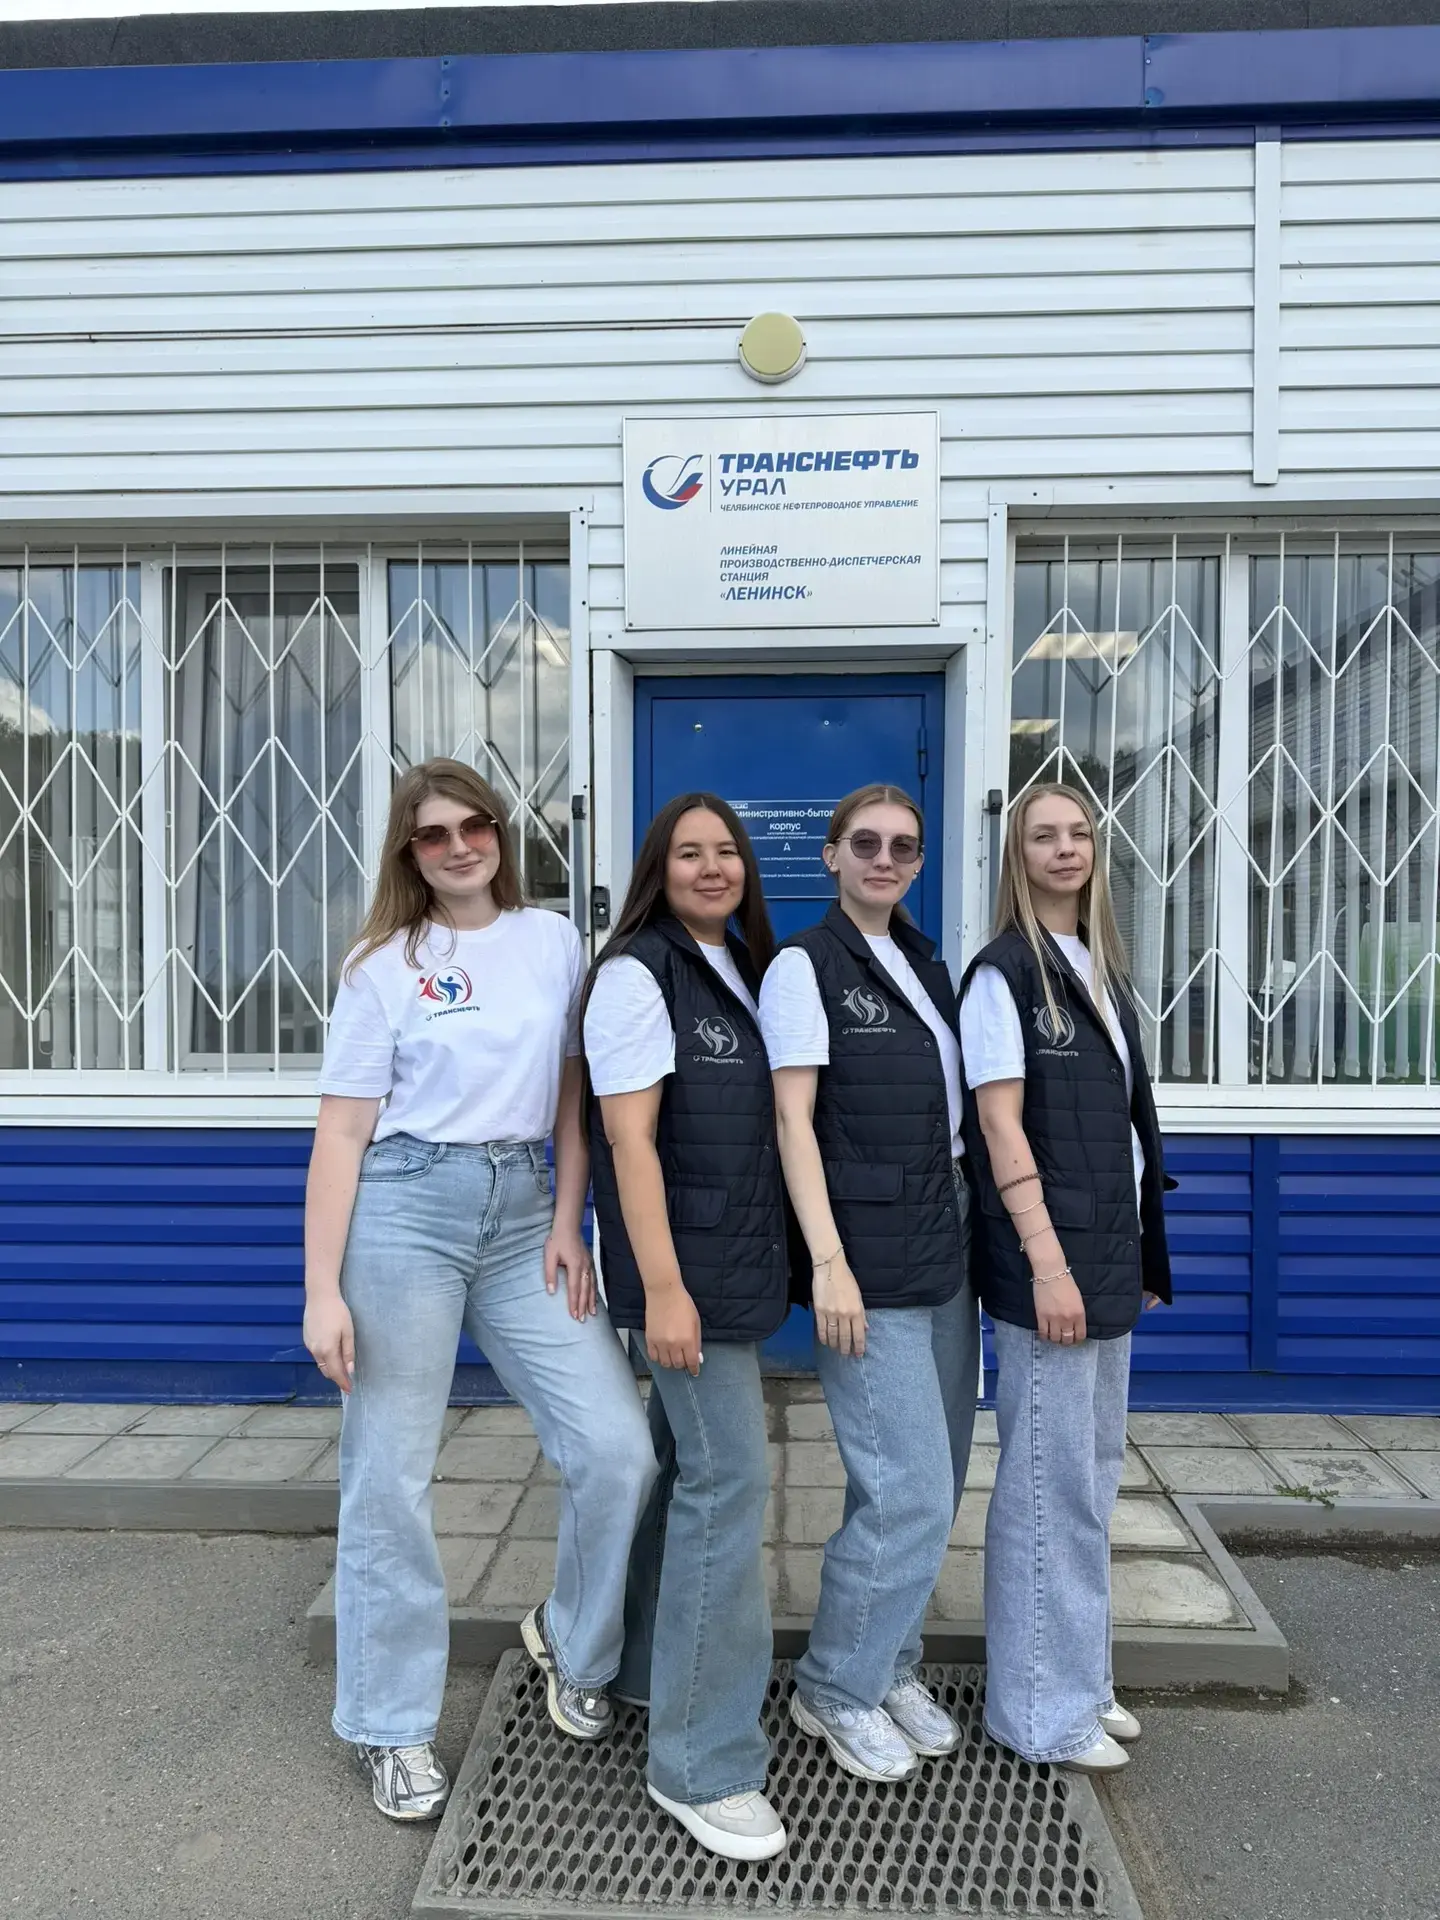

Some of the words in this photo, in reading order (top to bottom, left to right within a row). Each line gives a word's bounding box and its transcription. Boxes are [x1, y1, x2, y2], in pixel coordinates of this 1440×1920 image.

[718, 449, 919, 474] ТРАНСНЕФТЬ
[720, 477, 787, 496] УРАЛ
[720, 502, 781, 512] ЧЕЛЯБИНСКОЕ
[783, 500, 862, 511] НЕФТЕПРОВОДНОЕ
[864, 499, 919, 509] УПРАВЛЕНИЕ
[720, 543, 778, 556] ЛИНЕЙНАЯ
[719, 555, 921, 569] ПРОИЗВОДСТВЕННО-ДИСПЕТЧЕРСКАЯ
[720, 572, 769, 582] СТАНЦИЯ
[720, 585, 813, 601] «ЛЕНИНСК»
[735, 807, 835, 819] министративно-бытов
[769, 822, 801, 832] корпус
[433, 1006, 480, 1018] ТРАНСНЕФТЬ
